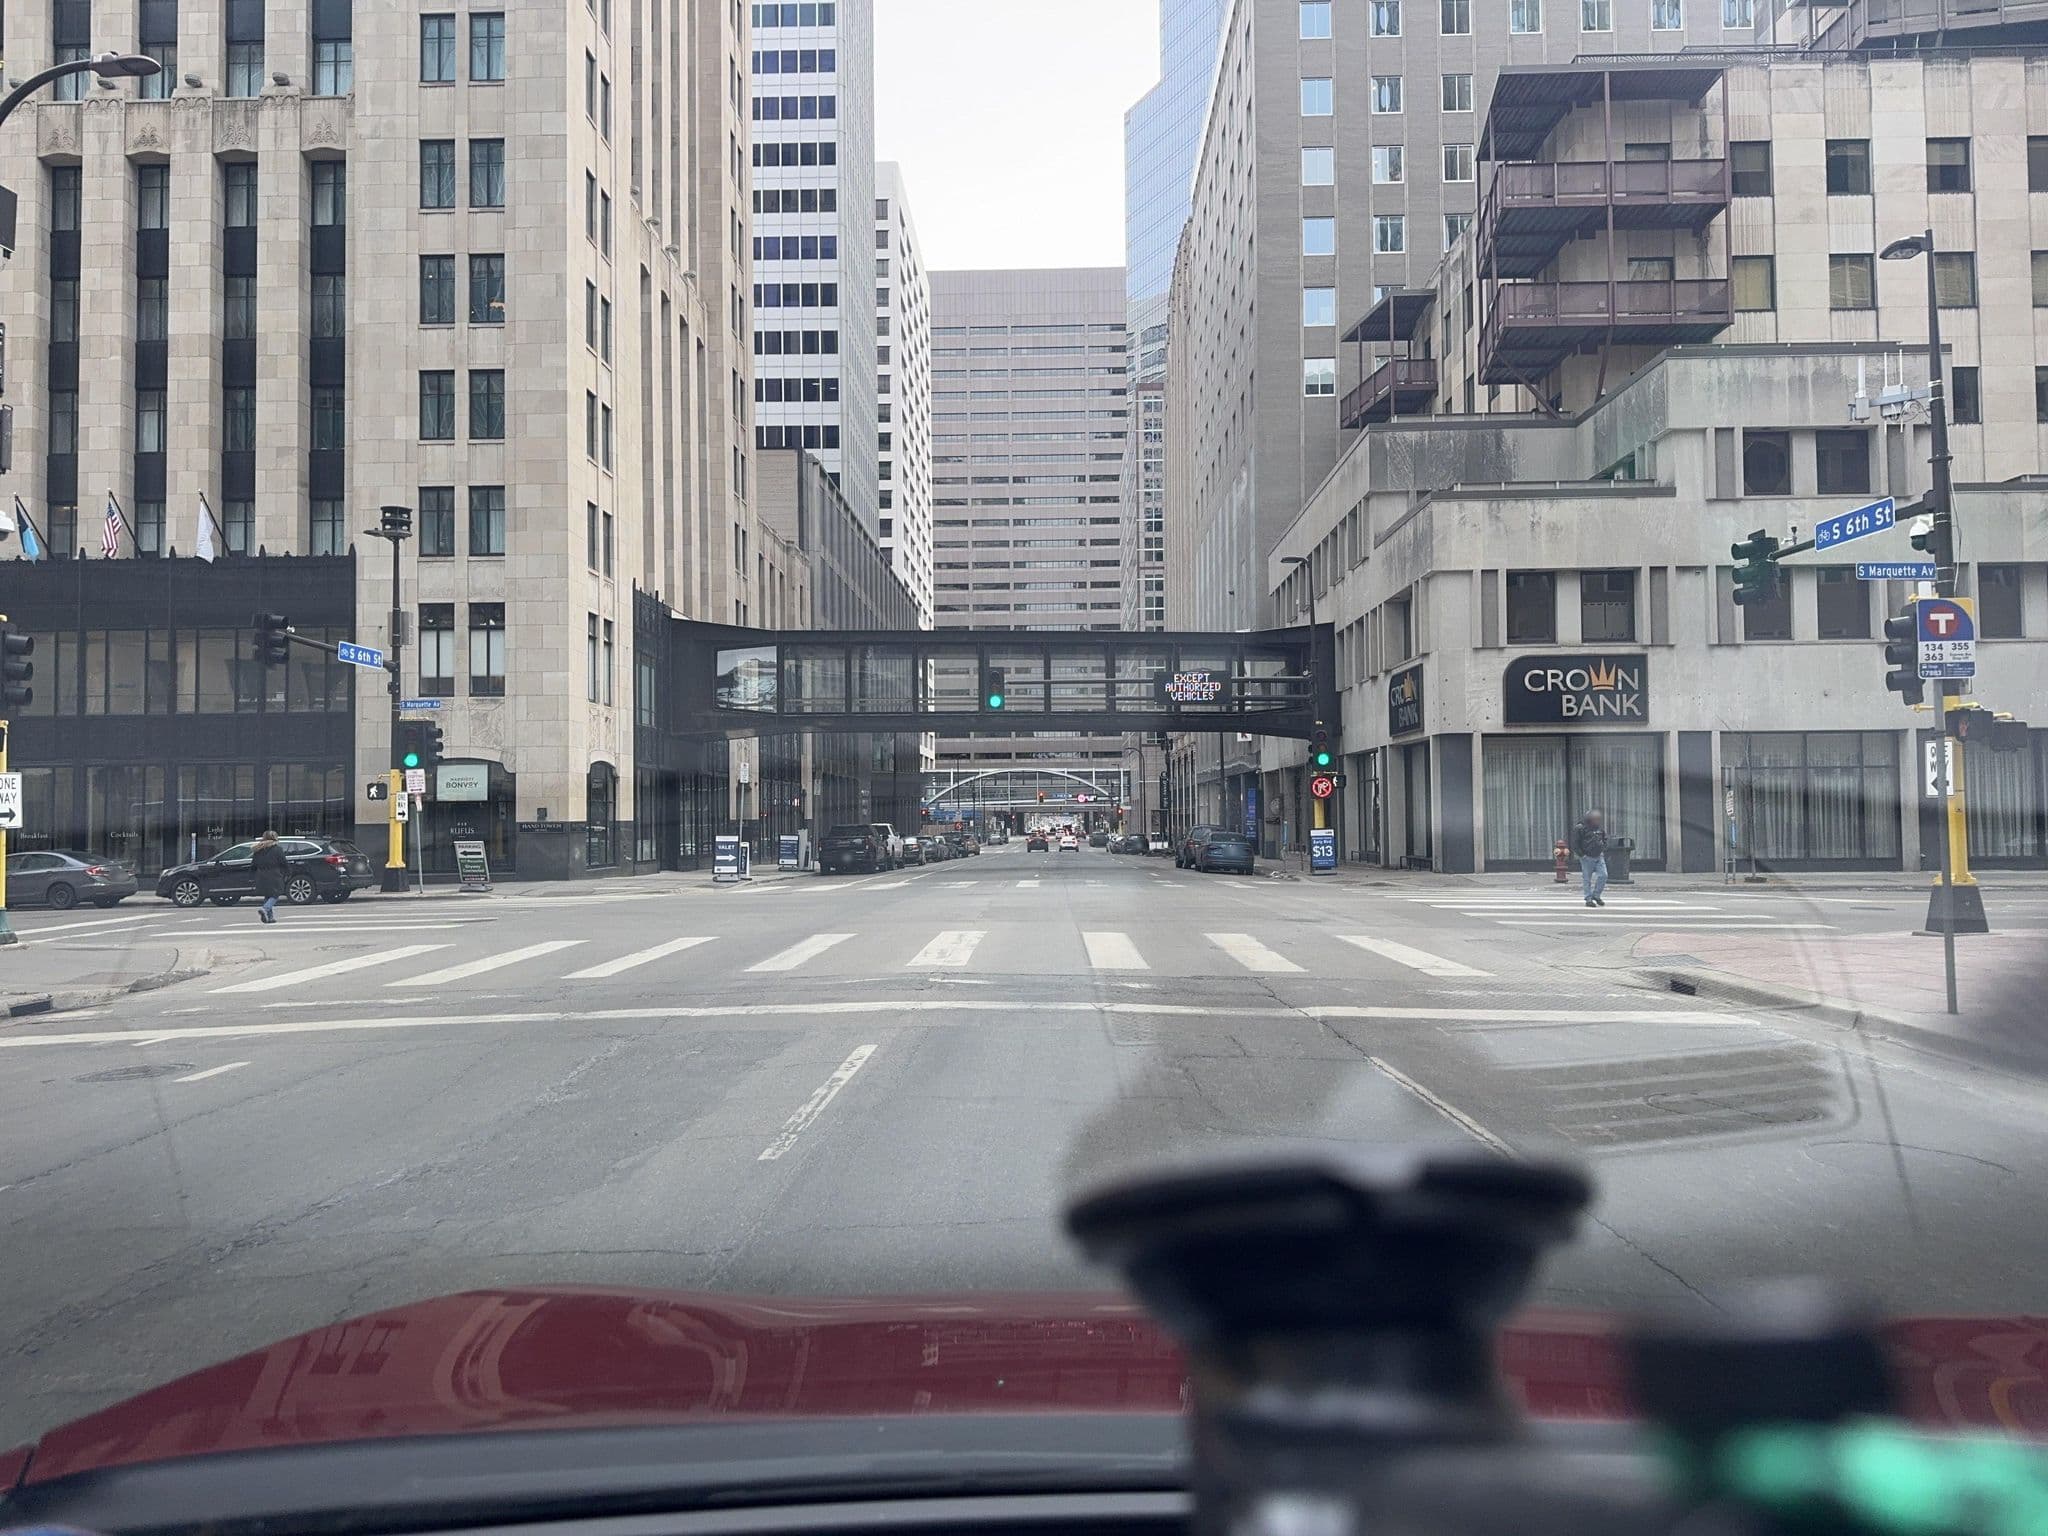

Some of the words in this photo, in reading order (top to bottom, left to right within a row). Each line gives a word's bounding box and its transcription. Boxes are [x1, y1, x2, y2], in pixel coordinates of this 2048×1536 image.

[1832, 523, 1841, 540] S
[1846, 513, 1869, 535] 6th
[1875, 506, 1891, 525] St
[1858, 566, 1865, 577] S
[1869, 566, 1917, 579] Marquette
[1921, 566, 1934, 576] Av
[1929, 613, 1955, 634] T
[1924, 643, 1944, 651] 134
[1951, 642, 1970, 651] 355
[349, 648, 356, 659] S
[357, 650, 371, 662] 6th
[373, 653, 381, 665] St
[1924, 653, 1944, 661] 363
[1173, 673, 1210, 683] EXCEPT
[1165, 682, 1221, 692] AUTHORIZED
[1171, 691, 1214, 701] VEHICLES
[1562, 694, 1642, 717] BANK
[1399, 703, 1419, 727] BANK
[1312, 845, 1333, 857] $13
